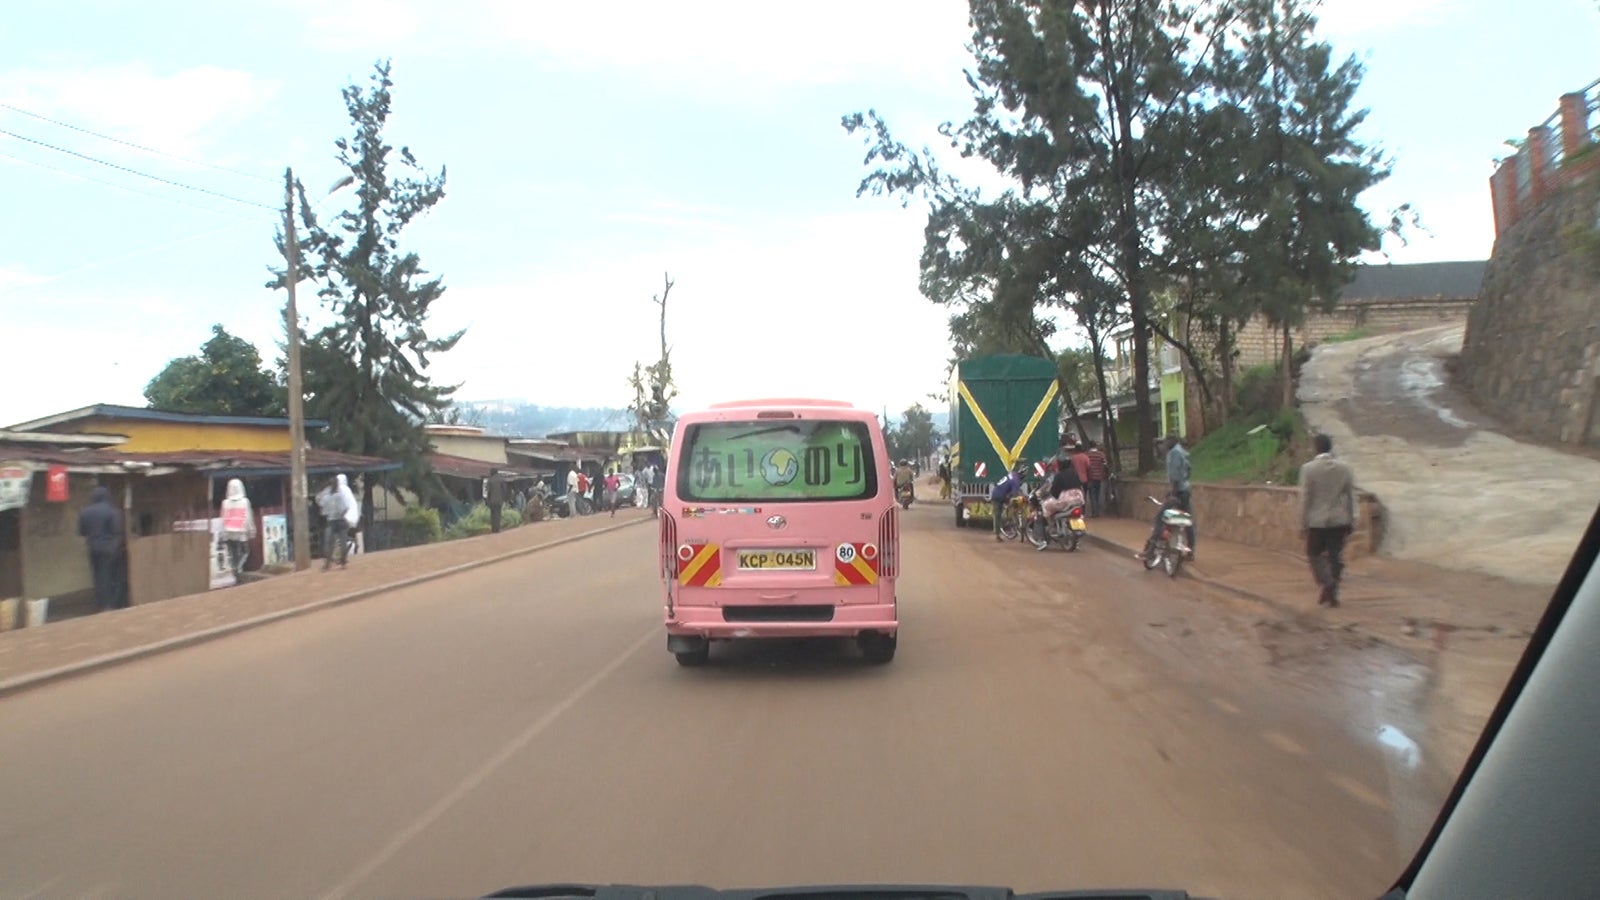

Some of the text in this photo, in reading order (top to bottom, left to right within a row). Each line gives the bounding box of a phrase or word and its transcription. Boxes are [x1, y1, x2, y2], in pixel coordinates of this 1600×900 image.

[839, 547, 854, 558] 80
[740, 552, 814, 568] KCP 045N
